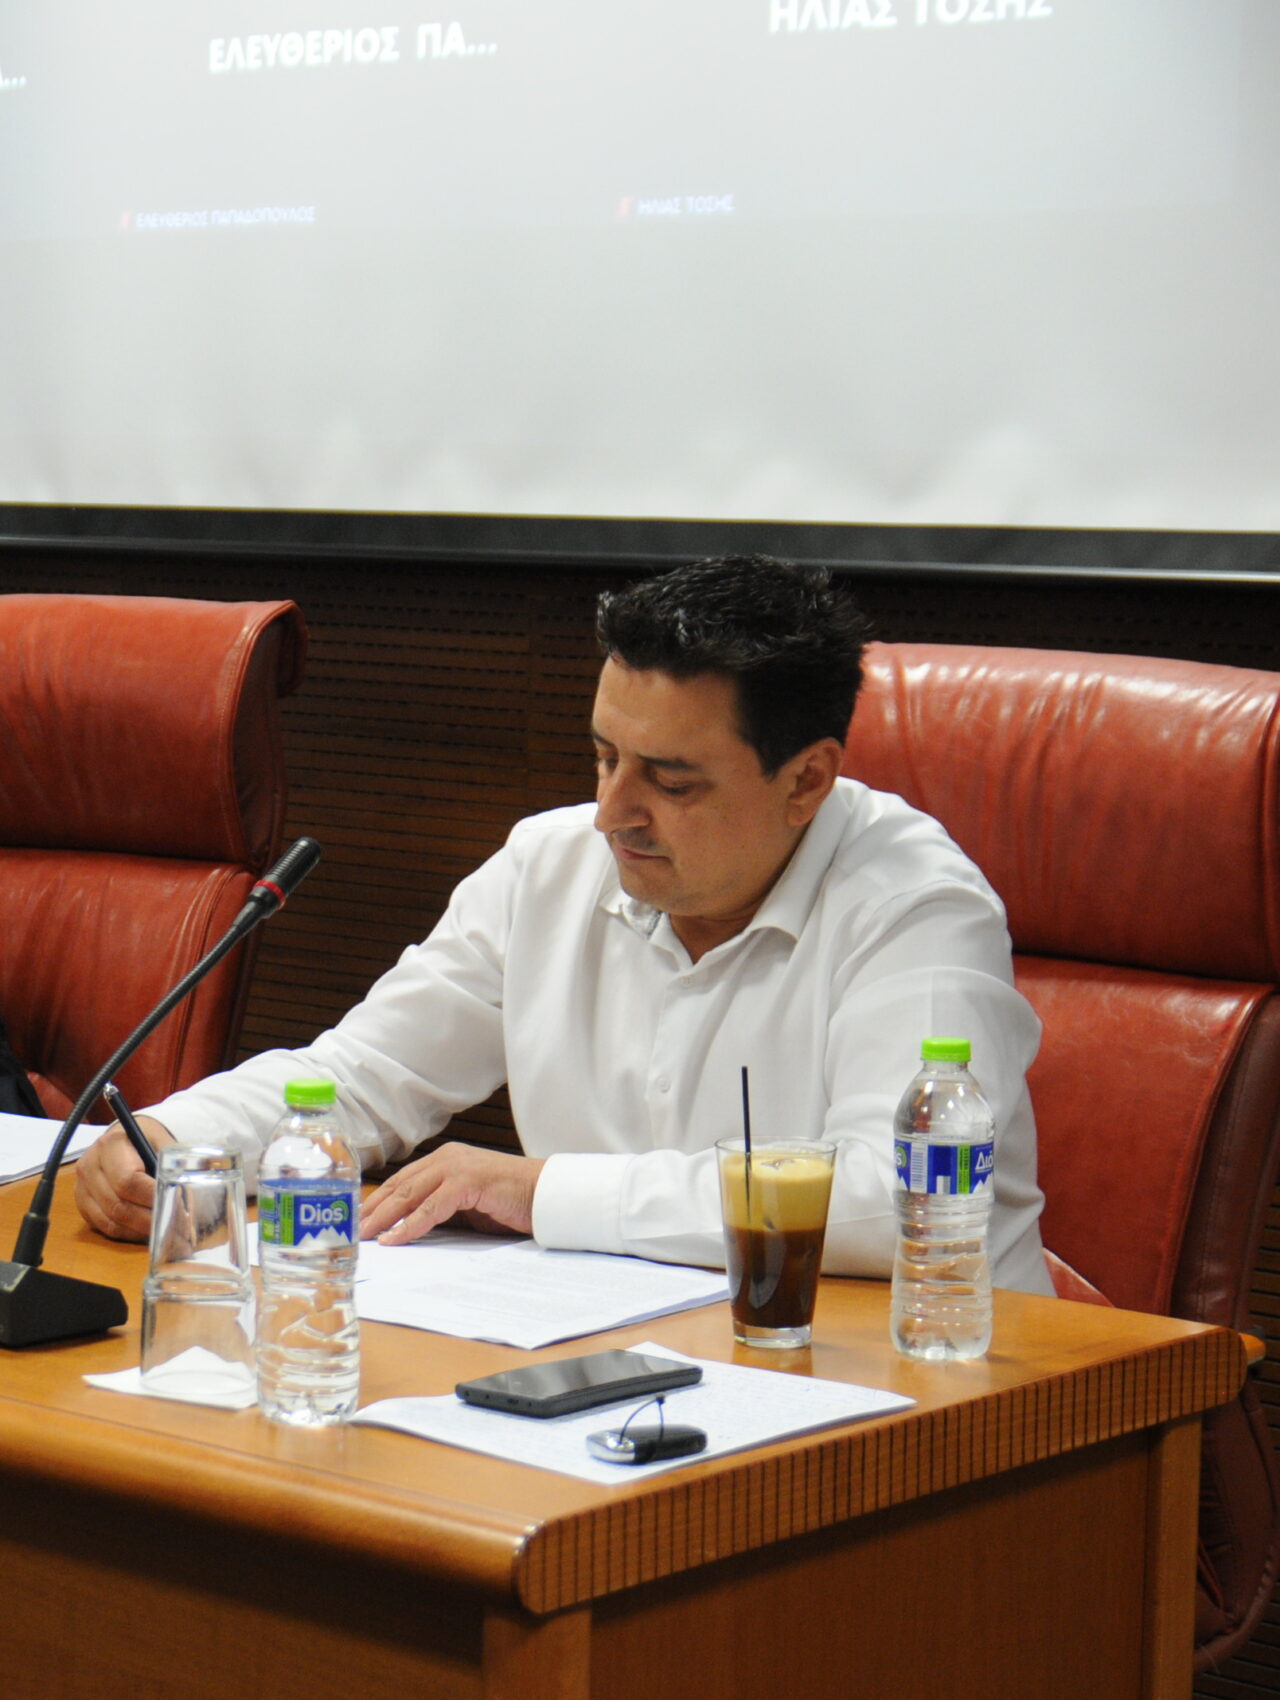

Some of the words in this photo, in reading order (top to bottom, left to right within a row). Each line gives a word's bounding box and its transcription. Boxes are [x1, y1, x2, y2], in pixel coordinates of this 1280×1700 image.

[768, 0, 899, 34] ΗΛΙΑΣ
[209, 25, 401, 73] ΕΛΕΥΘΕΡΙΟΣ
[417, 20, 499, 60] ΠΑ...
[299, 1203, 344, 1225] Dios
